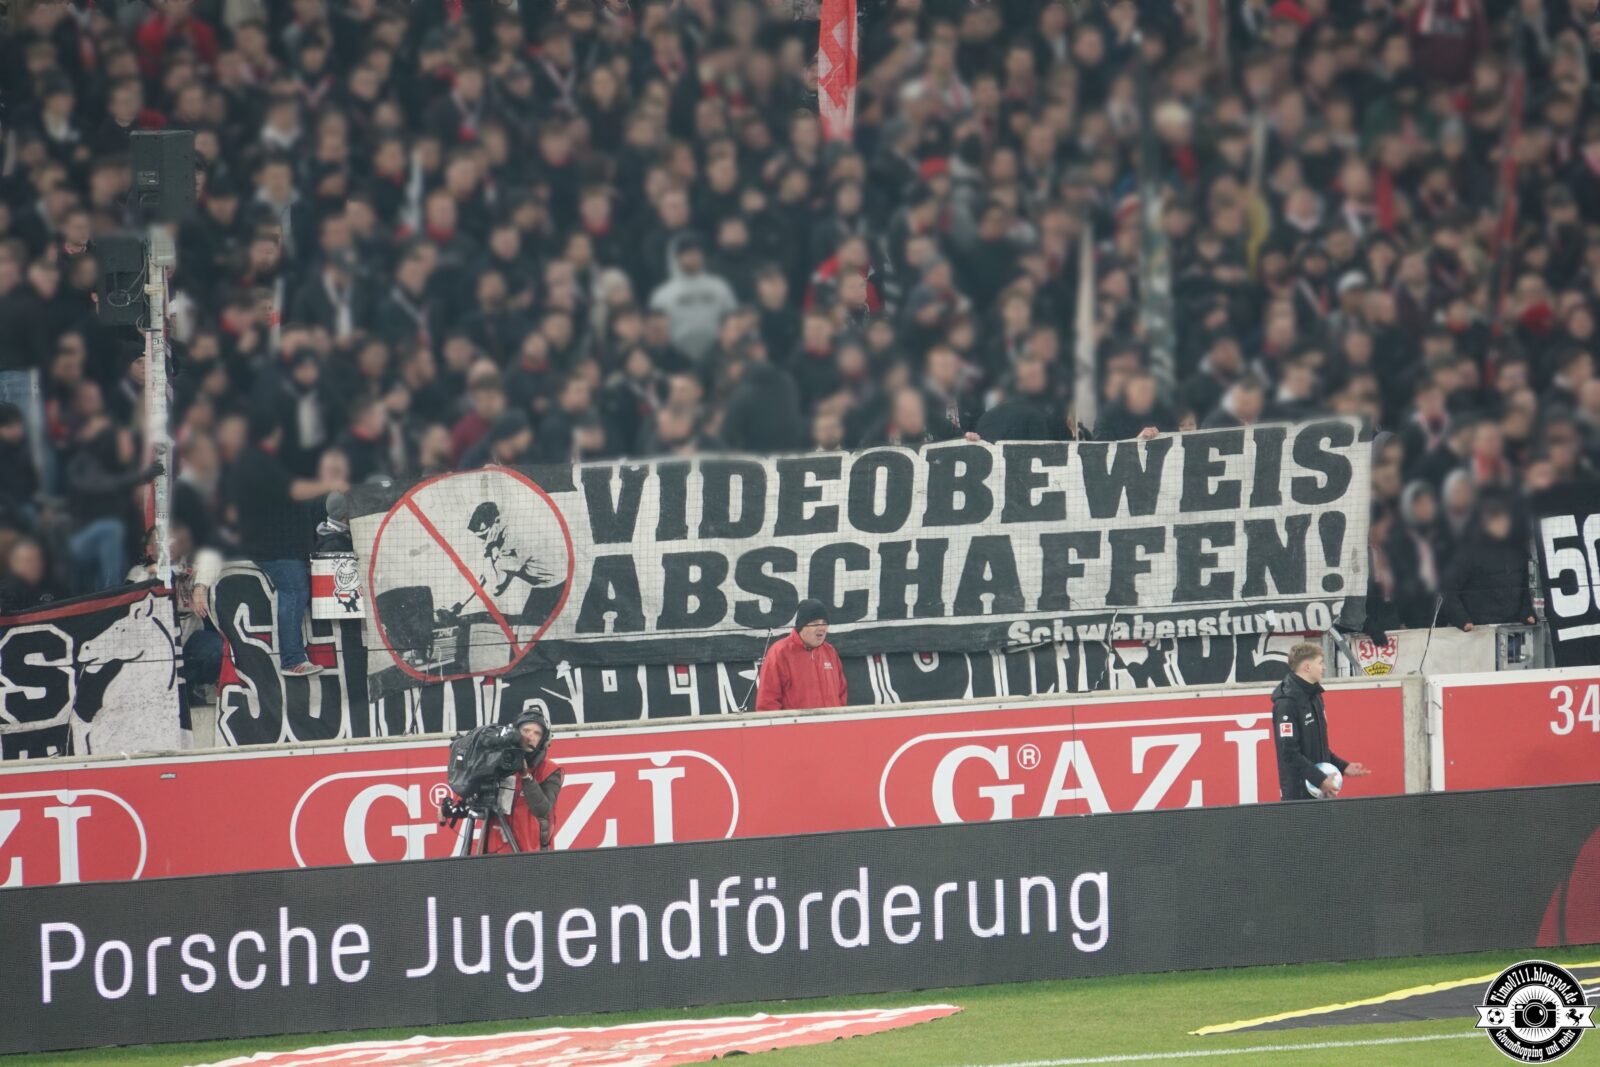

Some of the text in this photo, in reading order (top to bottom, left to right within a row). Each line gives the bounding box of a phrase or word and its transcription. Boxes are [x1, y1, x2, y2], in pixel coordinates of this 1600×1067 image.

[581, 422, 1354, 544] VIDEOBEWEIS
[575, 511, 1347, 634] ABSCHAFFEN!
[40, 866, 1110, 1004] Porsche Jugendförderung
